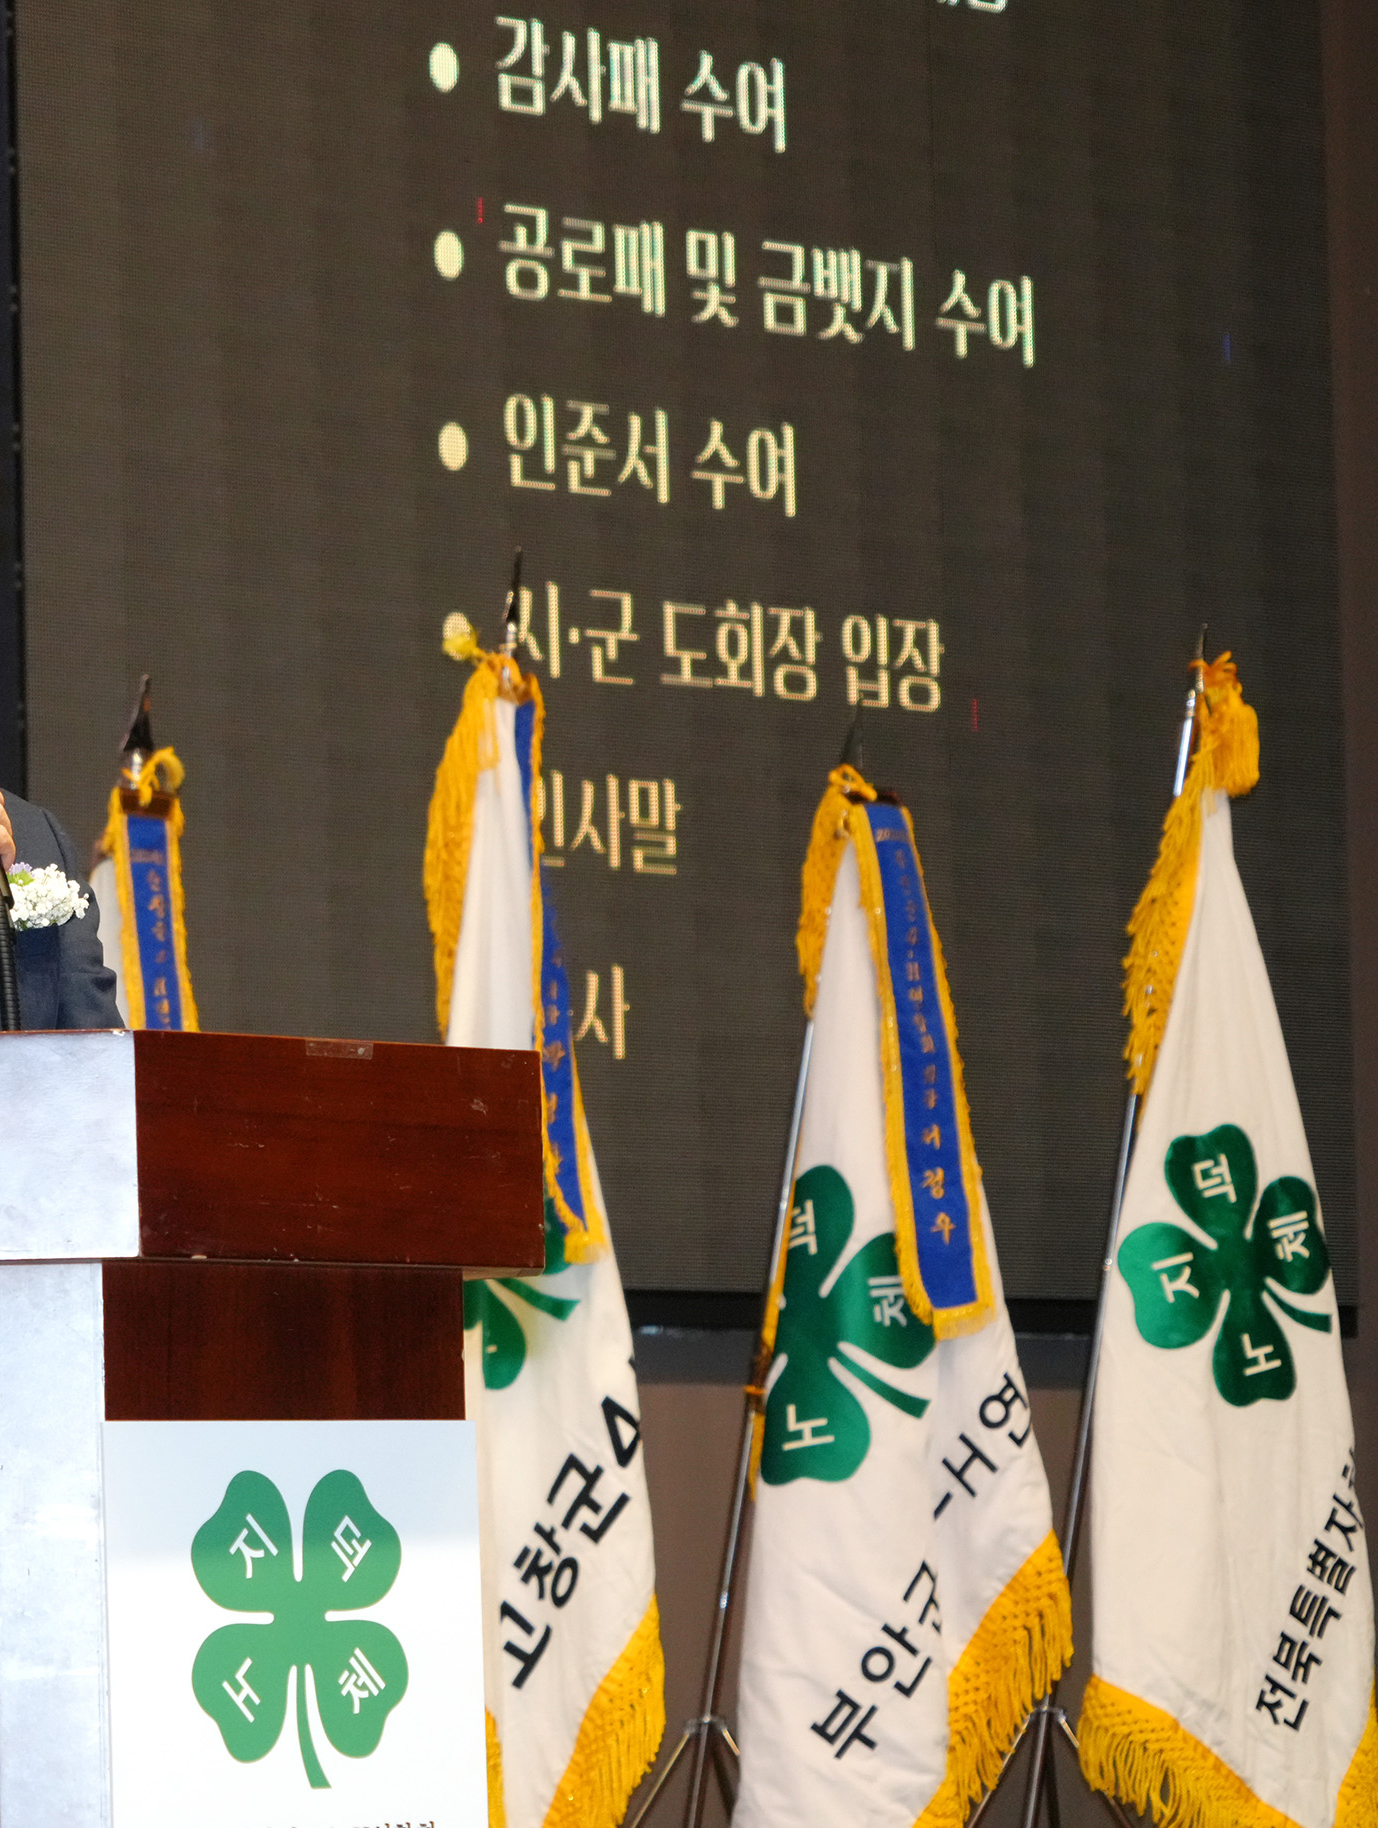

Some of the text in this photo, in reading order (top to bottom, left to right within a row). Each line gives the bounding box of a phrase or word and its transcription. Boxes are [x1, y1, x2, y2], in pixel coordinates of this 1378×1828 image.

[495, 16, 786, 153] 감사패 수여
[498, 203, 1035, 368] 공로패 및 금뱃지 수여
[504, 393, 797, 518] 인준서 수여
[661, 599, 822, 700] 도회장
[841, 613, 945, 713] 입장
[575, 963, 630, 1060] 사
[1191, 1153, 1237, 1203] 덕
[1268, 1210, 1310, 1262] 체
[868, 1275, 907, 1327] 체
[1151, 1251, 1200, 1303] 지
[1241, 1333, 1282, 1376] 노
[782, 1404, 835, 1451] 노
[229, 1513, 279, 1579] 지
[330, 1514, 372, 1583] 덕
[221, 1656, 261, 1723] 노
[338, 1646, 386, 1714] 체
